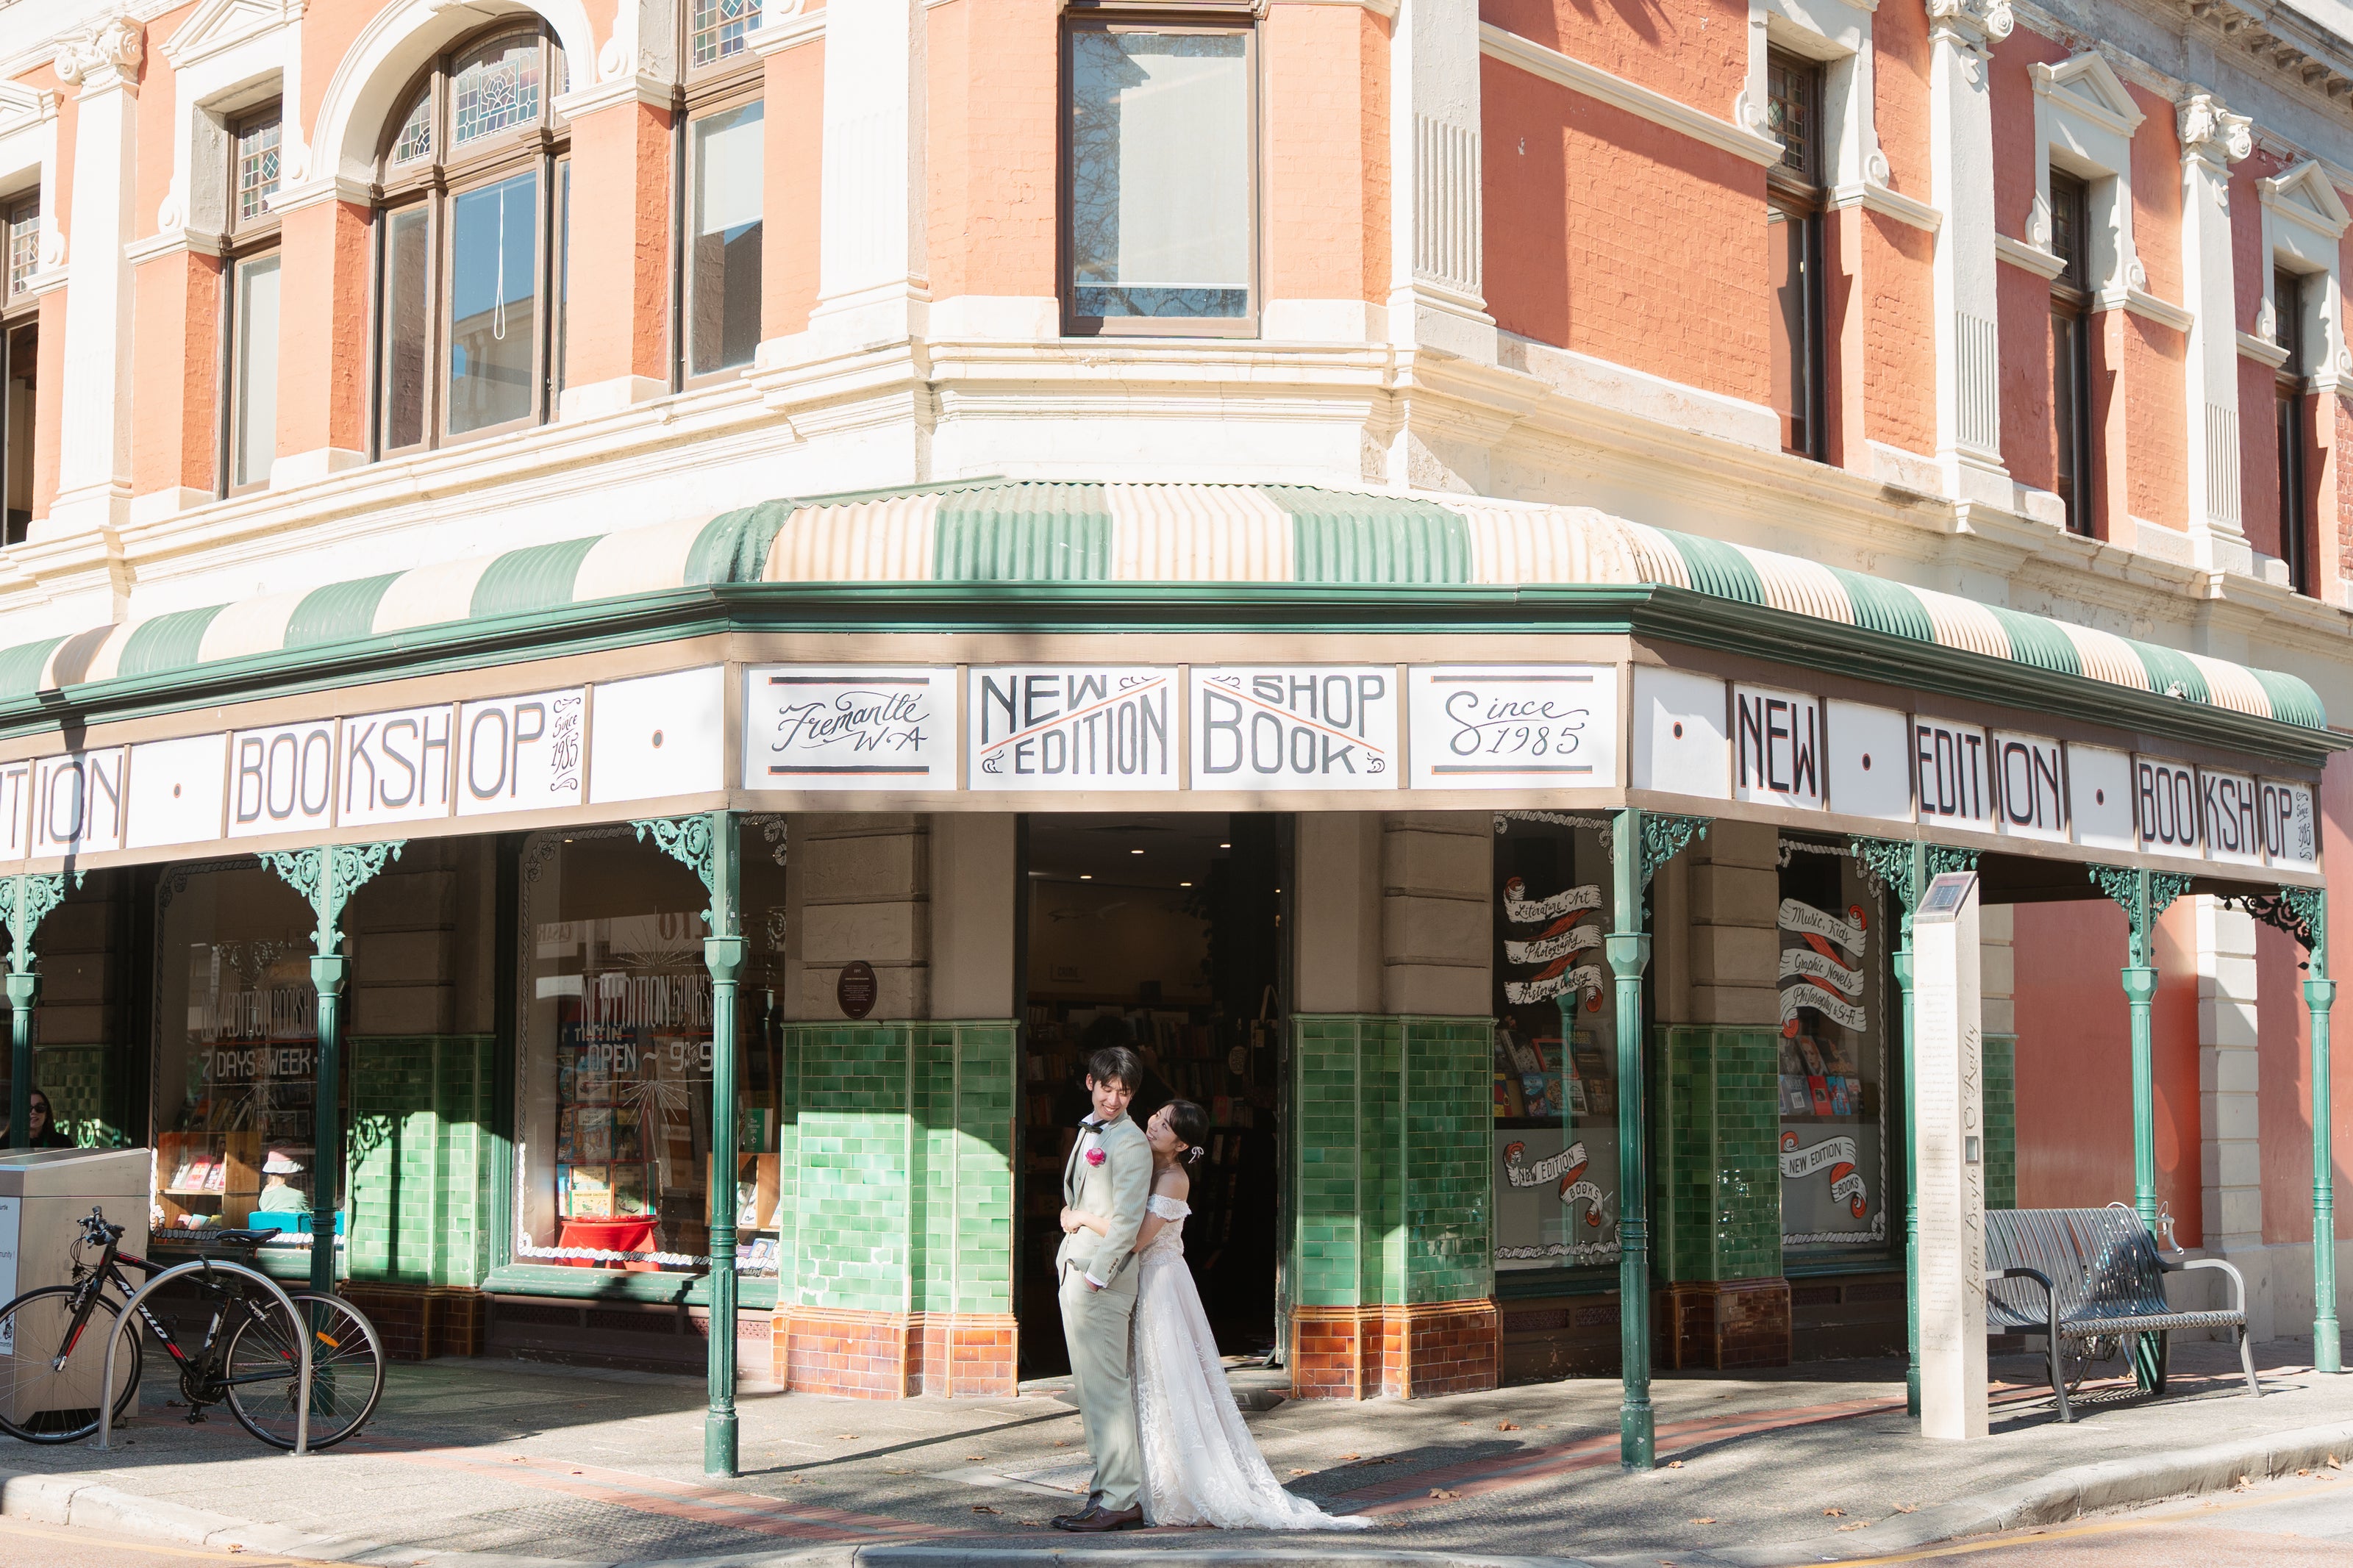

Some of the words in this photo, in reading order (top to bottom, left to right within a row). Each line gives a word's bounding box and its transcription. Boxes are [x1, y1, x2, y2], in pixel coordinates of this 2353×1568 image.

[551, 713, 579, 737] Since
[772, 691, 929, 751] Fremantle
[982, 674, 1107, 744] NEW
[1253, 674, 1385, 738] SHOP
[1445, 690, 1590, 756] Since
[1015, 687, 1168, 775] EDITION
[1203, 687, 1356, 774] BOOK
[1486, 722, 1585, 755] 1985
[236, 701, 546, 825] BOOKSHOP
[550, 731, 579, 775] 1985
[1738, 693, 1816, 798] NEW
[1915, 724, 2061, 832] EDITION
[2138, 762, 2292, 859] BOOKSHOP
[2298, 822, 2312, 848] 1985
[1565, 890, 1590, 905] Art
[1828, 919, 1852, 943] Kids
[1794, 953, 1824, 973] Graphic
[1827, 964, 1854, 989] Novels
[273, 987, 318, 1037] BOOKSHO
[201, 1051, 212, 1078] 7
[217, 1050, 255, 1078] DAYS
[268, 1048, 310, 1075] WEEK
[588, 1042, 636, 1073] OPEN
[1963, 1023, 1980, 1131] O'Reilly
[1541, 1150, 1574, 1179] EDITION
[1789, 1156, 1807, 1174] NEW
[1811, 1142, 1841, 1166] EDITION
[1569, 1184, 1600, 1199] BOOKS
[1838, 1177, 1859, 1195] BOOKS
[1965, 1169, 1980, 1240] Boyle
[1965, 1245, 1985, 1309] John
